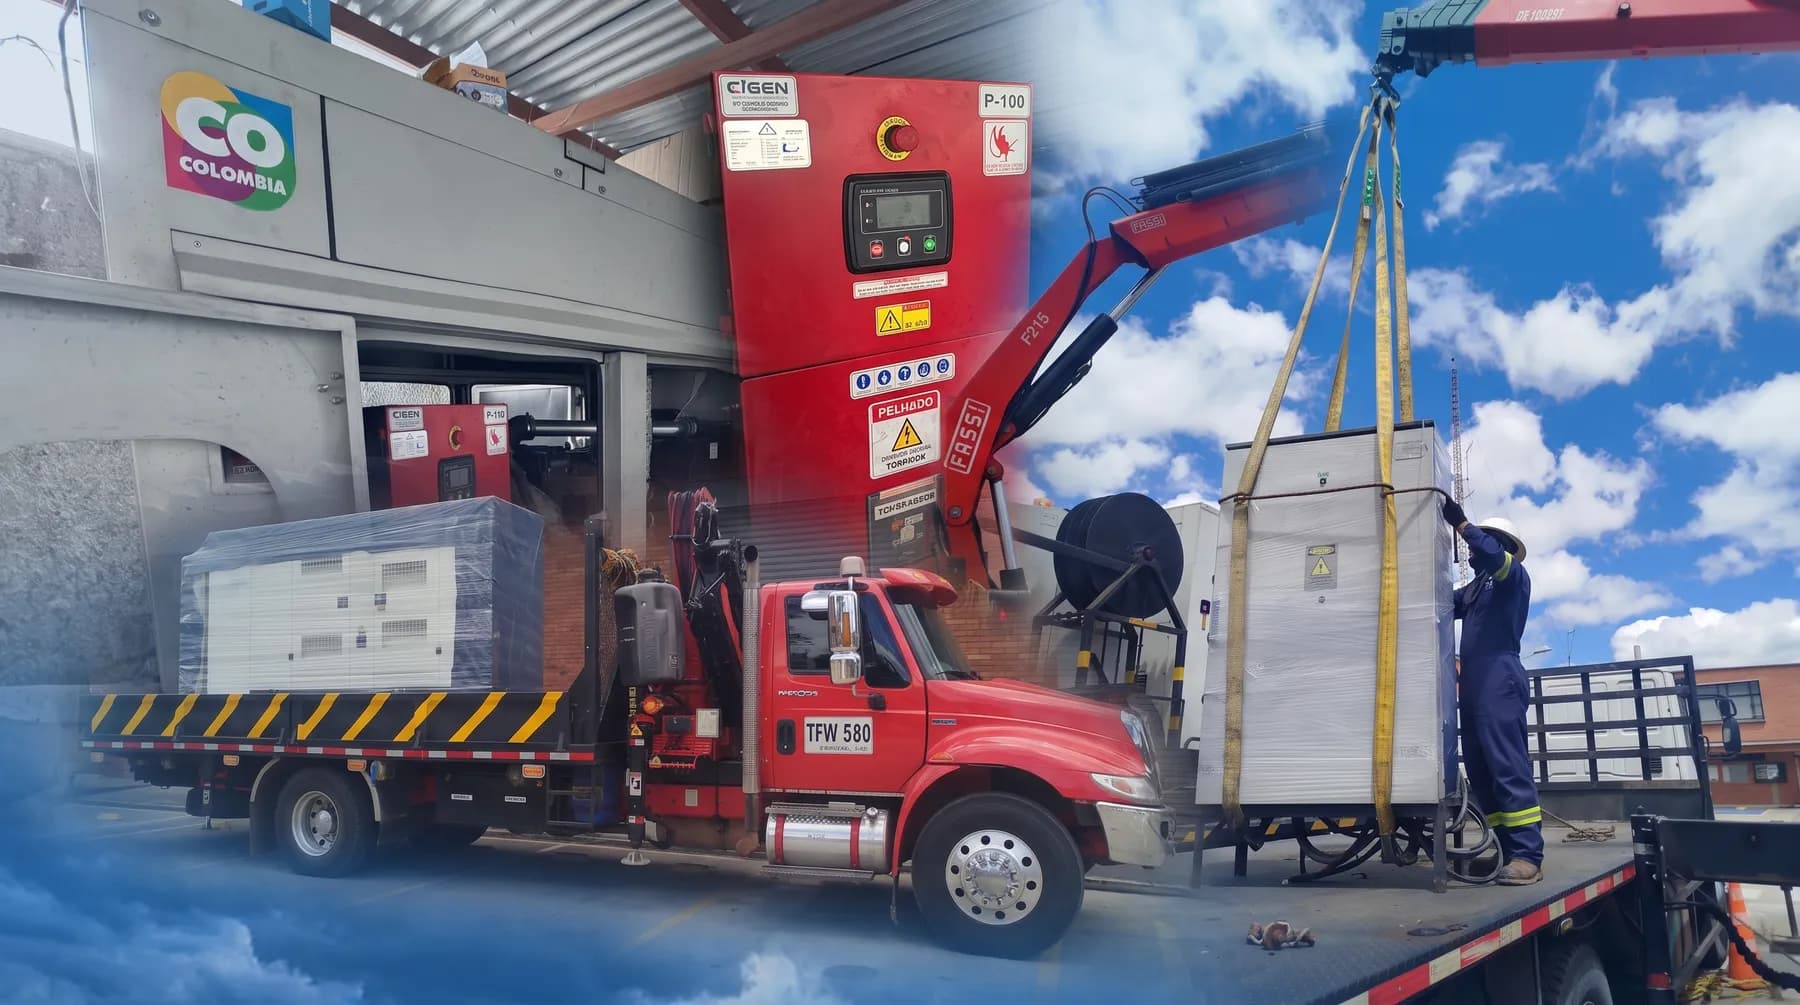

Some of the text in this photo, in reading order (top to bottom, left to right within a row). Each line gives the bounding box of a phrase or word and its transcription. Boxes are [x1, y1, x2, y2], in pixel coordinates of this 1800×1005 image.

[984, 94, 1025, 109] P-100
[175, 97, 285, 168] CO
[179, 155, 287, 196] COLOMBIA
[1020, 311, 1050, 347] F215
[486, 410, 505, 419] P-110
[951, 403, 986, 469] FASSI
[806, 722, 871, 743] TFW 580
